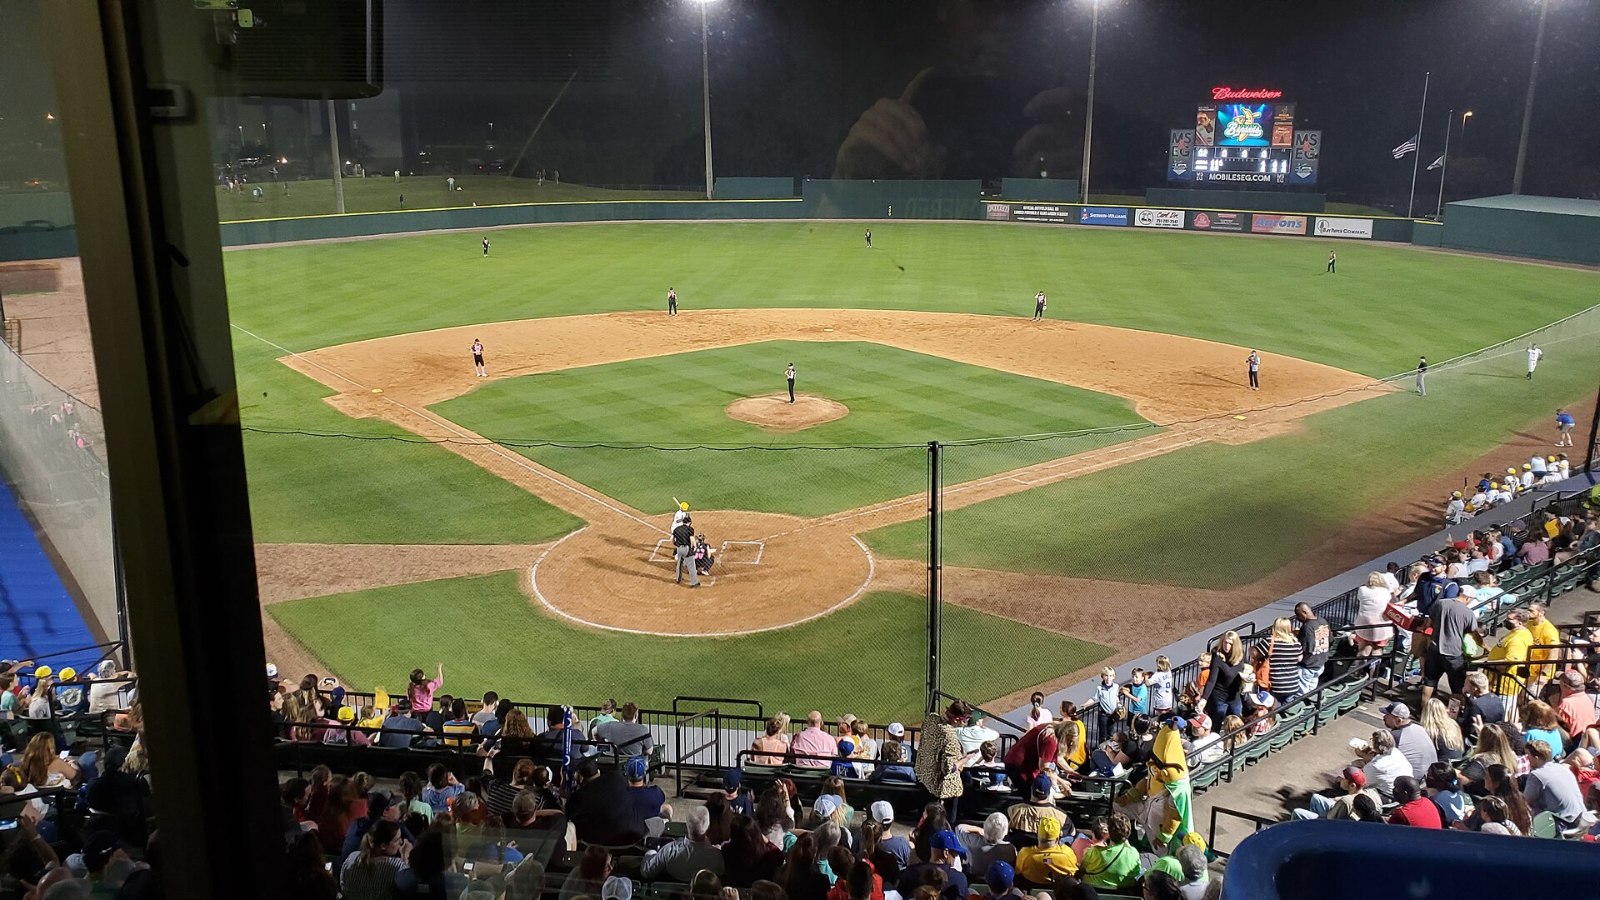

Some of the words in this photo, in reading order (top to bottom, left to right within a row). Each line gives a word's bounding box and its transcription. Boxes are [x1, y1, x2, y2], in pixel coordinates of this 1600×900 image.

[1212, 86, 1282, 100] Budweiser
[1172, 132, 1191, 143] MS
[1295, 133, 1317, 146] MS
[1172, 146, 1190, 157] EG
[1295, 148, 1316, 159] EG
[1209, 173, 1271, 182] MOBILESEG.COM
[1255, 217, 1302, 228] Aaron's
